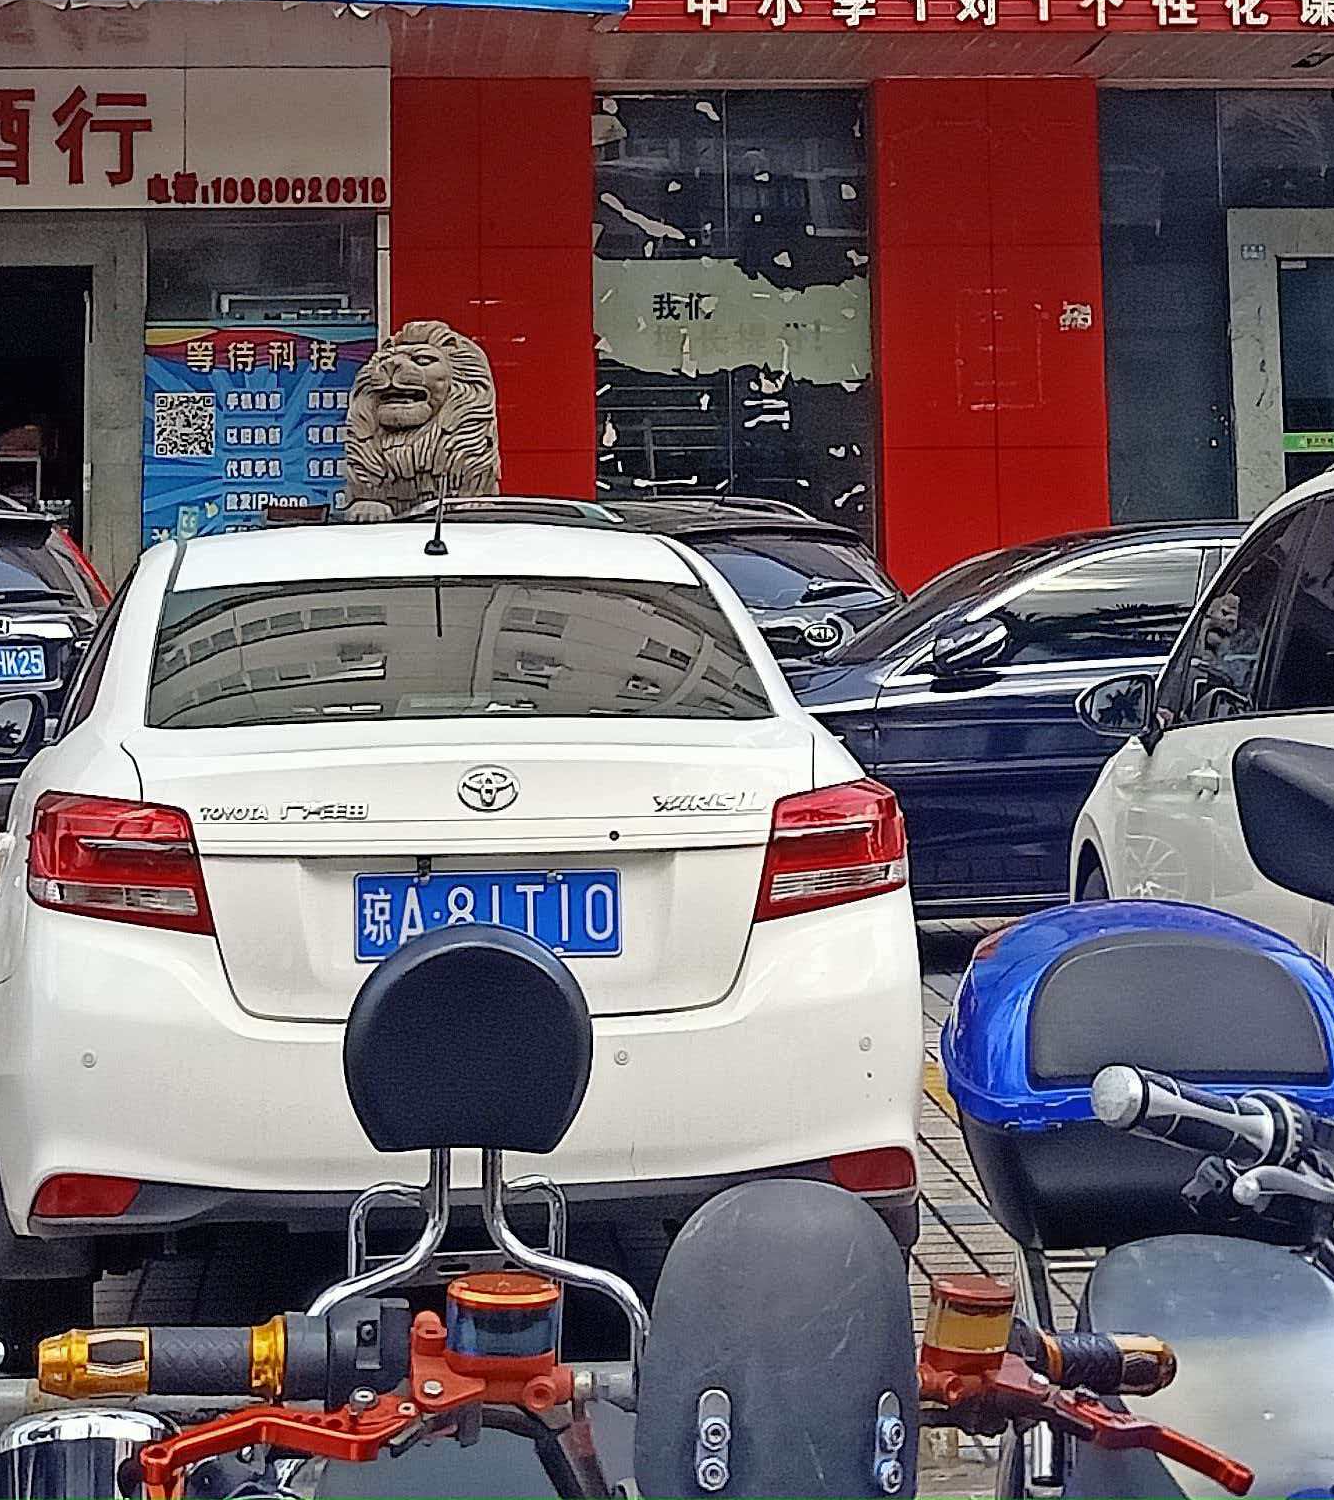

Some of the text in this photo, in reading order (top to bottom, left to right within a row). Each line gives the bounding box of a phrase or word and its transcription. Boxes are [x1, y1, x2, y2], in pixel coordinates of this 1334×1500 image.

[186, 341, 338, 373] 等待科技
[200, 805, 268, 821] TOYOTA
